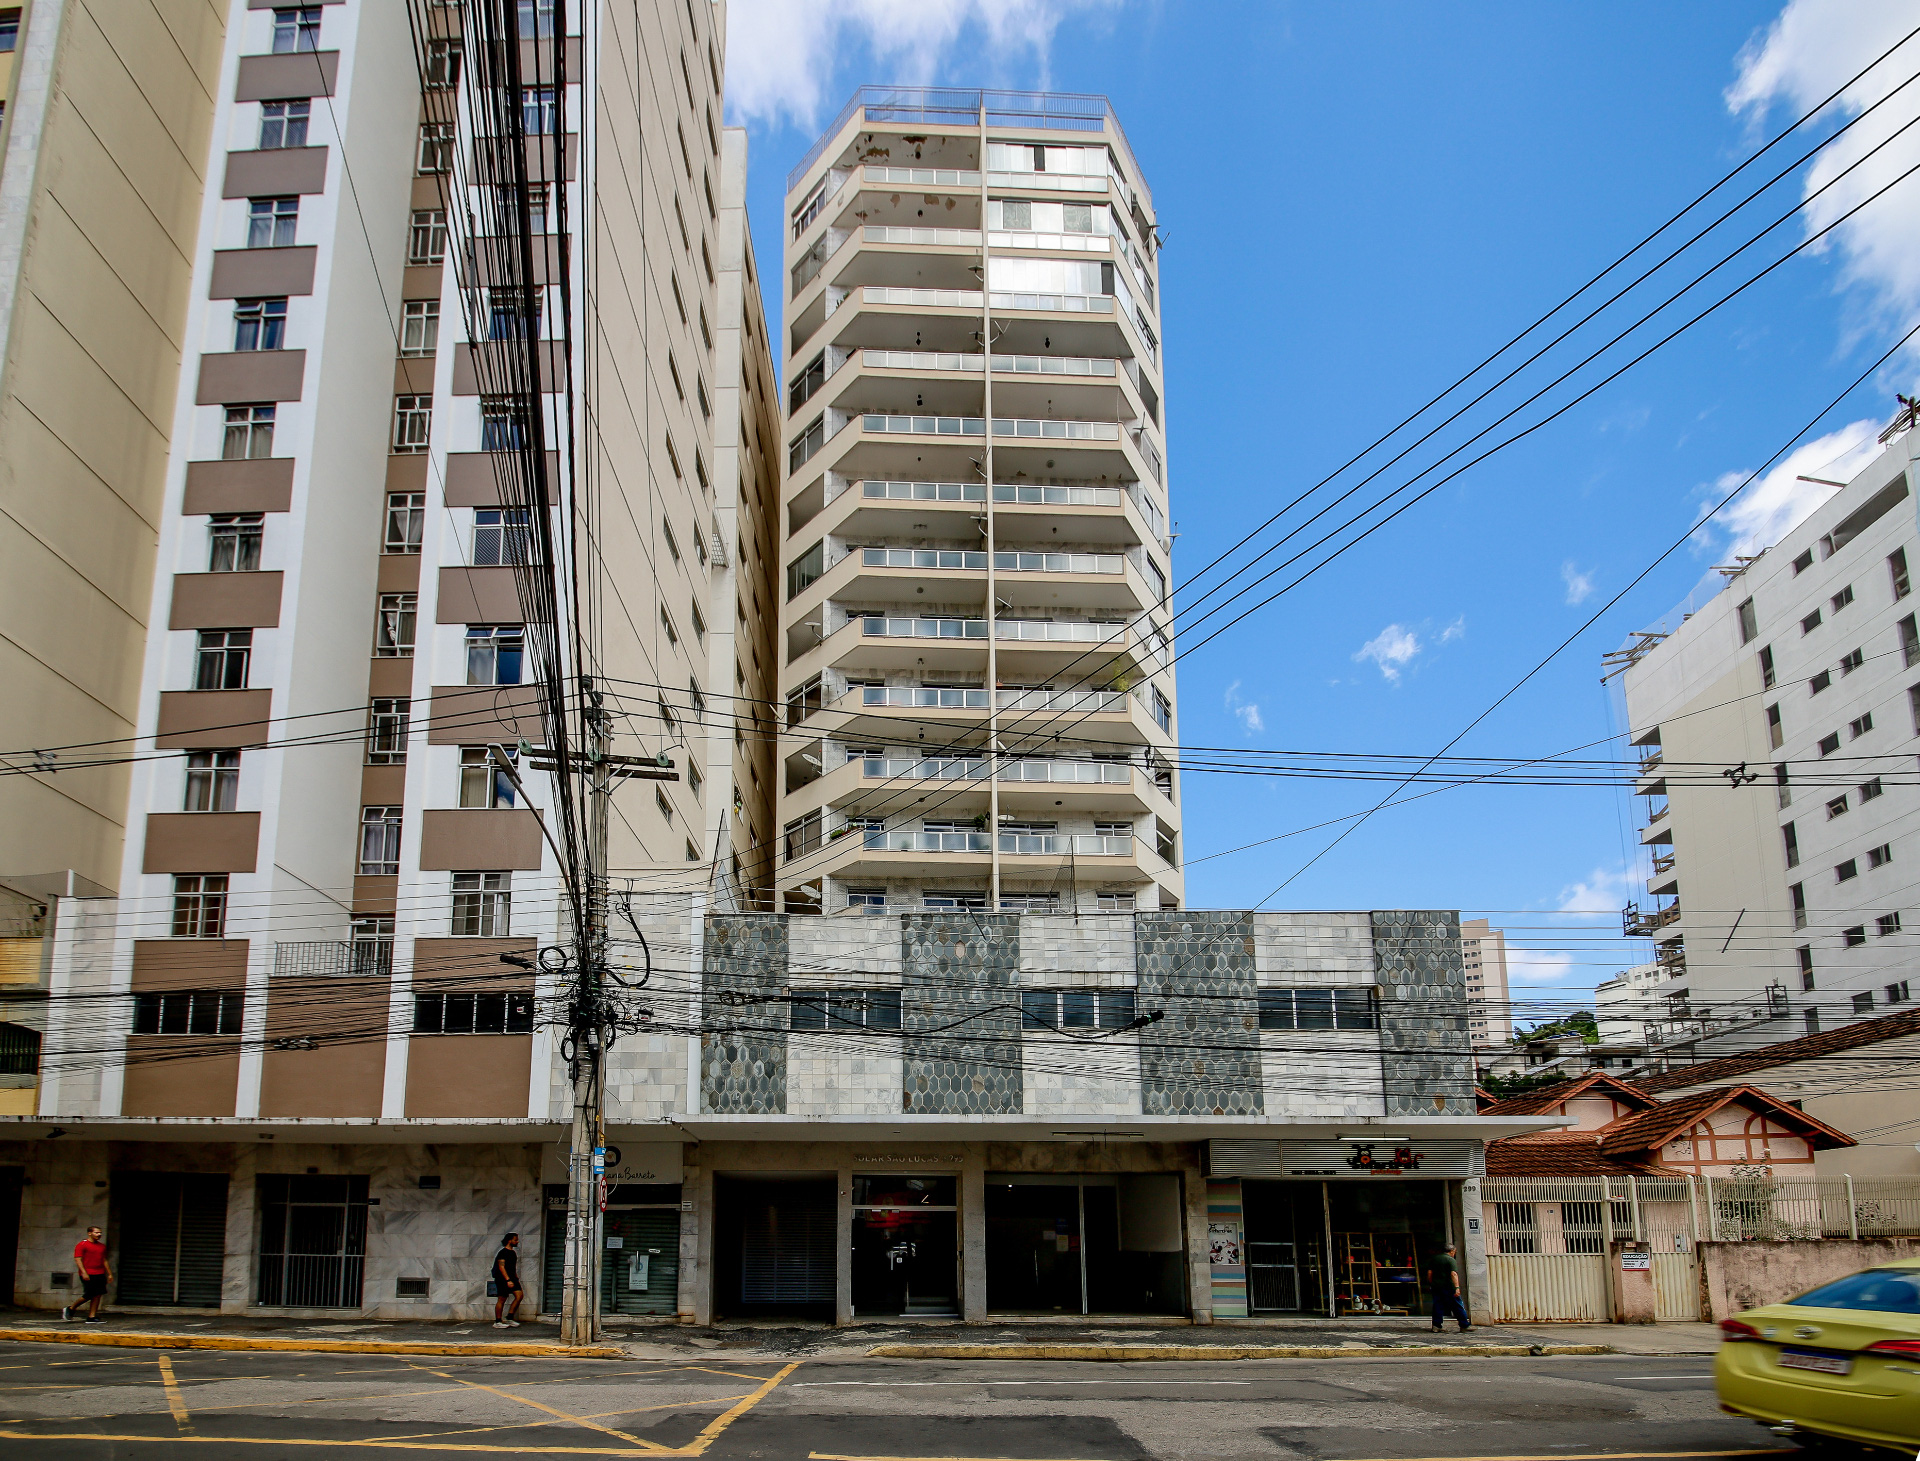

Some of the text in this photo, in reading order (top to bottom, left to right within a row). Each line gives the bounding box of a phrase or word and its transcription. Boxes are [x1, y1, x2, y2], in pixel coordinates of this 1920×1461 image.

[854, 1153, 884, 1162] SOLAR
[908, 1153, 939, 1162] LUCAS
[624, 1166, 656, 1180] Barreto
[548, 1196, 565, 1204] 287
